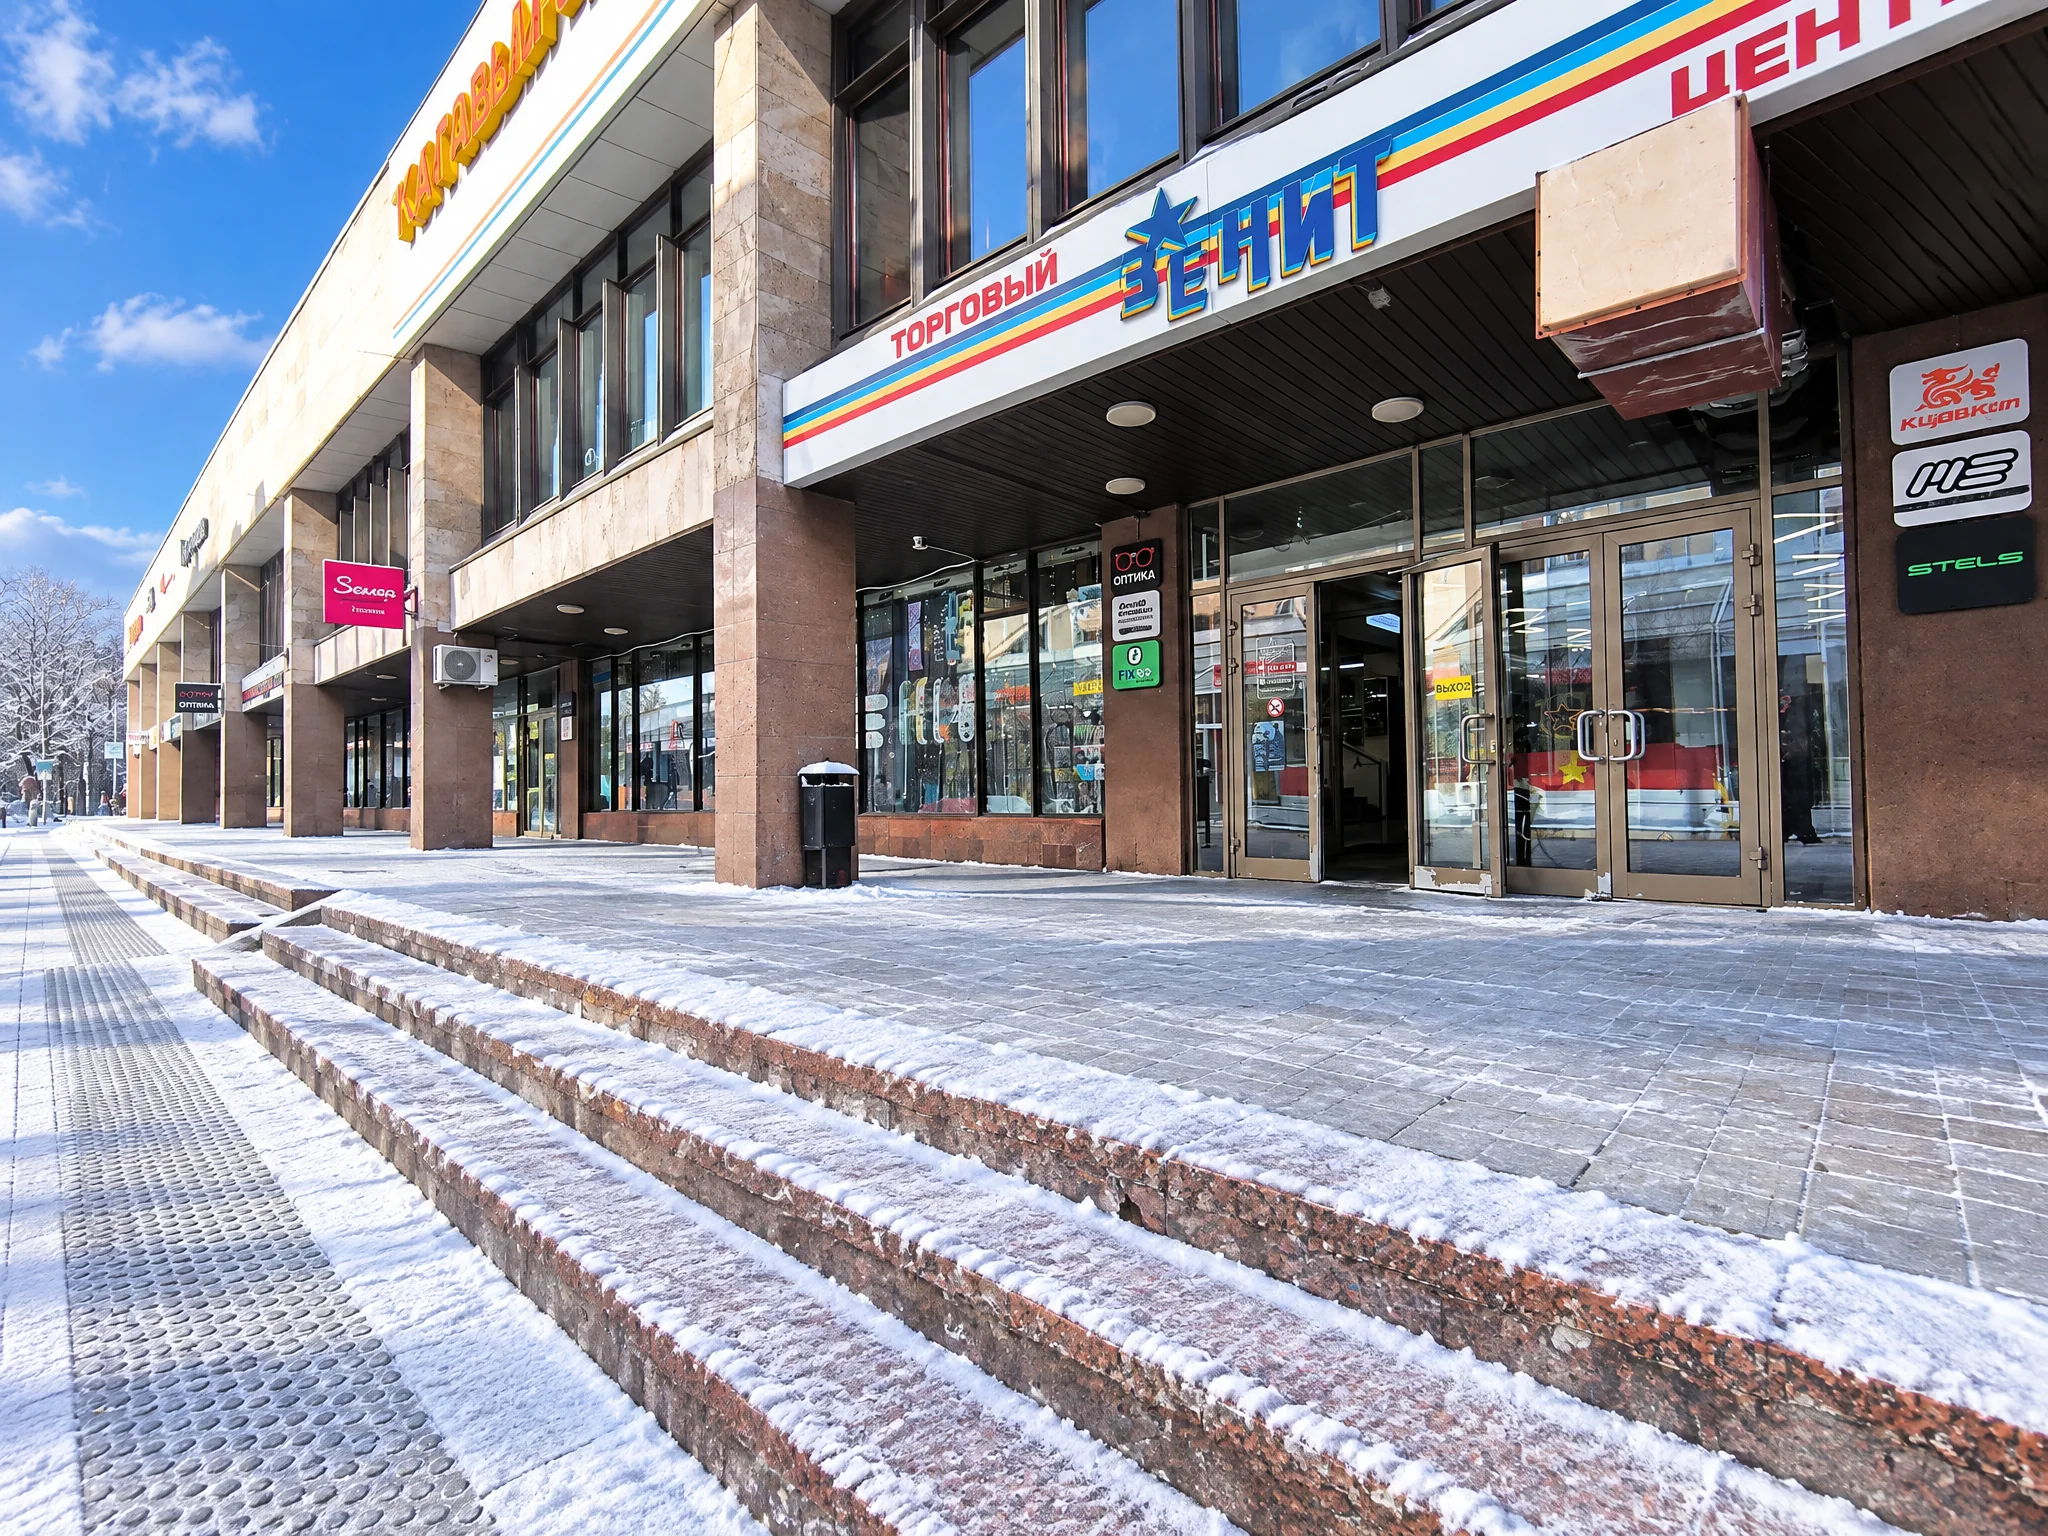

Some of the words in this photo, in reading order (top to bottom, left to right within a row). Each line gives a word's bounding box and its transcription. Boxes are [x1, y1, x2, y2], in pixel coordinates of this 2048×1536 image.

[890, 248, 1059, 359] ТОРГОВЫЙ
[1120, 134, 1393, 322] ЗЕНИТ
[1671, 0, 1960, 118] ЦЕН
[1907, 551, 2024, 577] STELS
[1113, 569, 1156, 586] ОПТИКА
